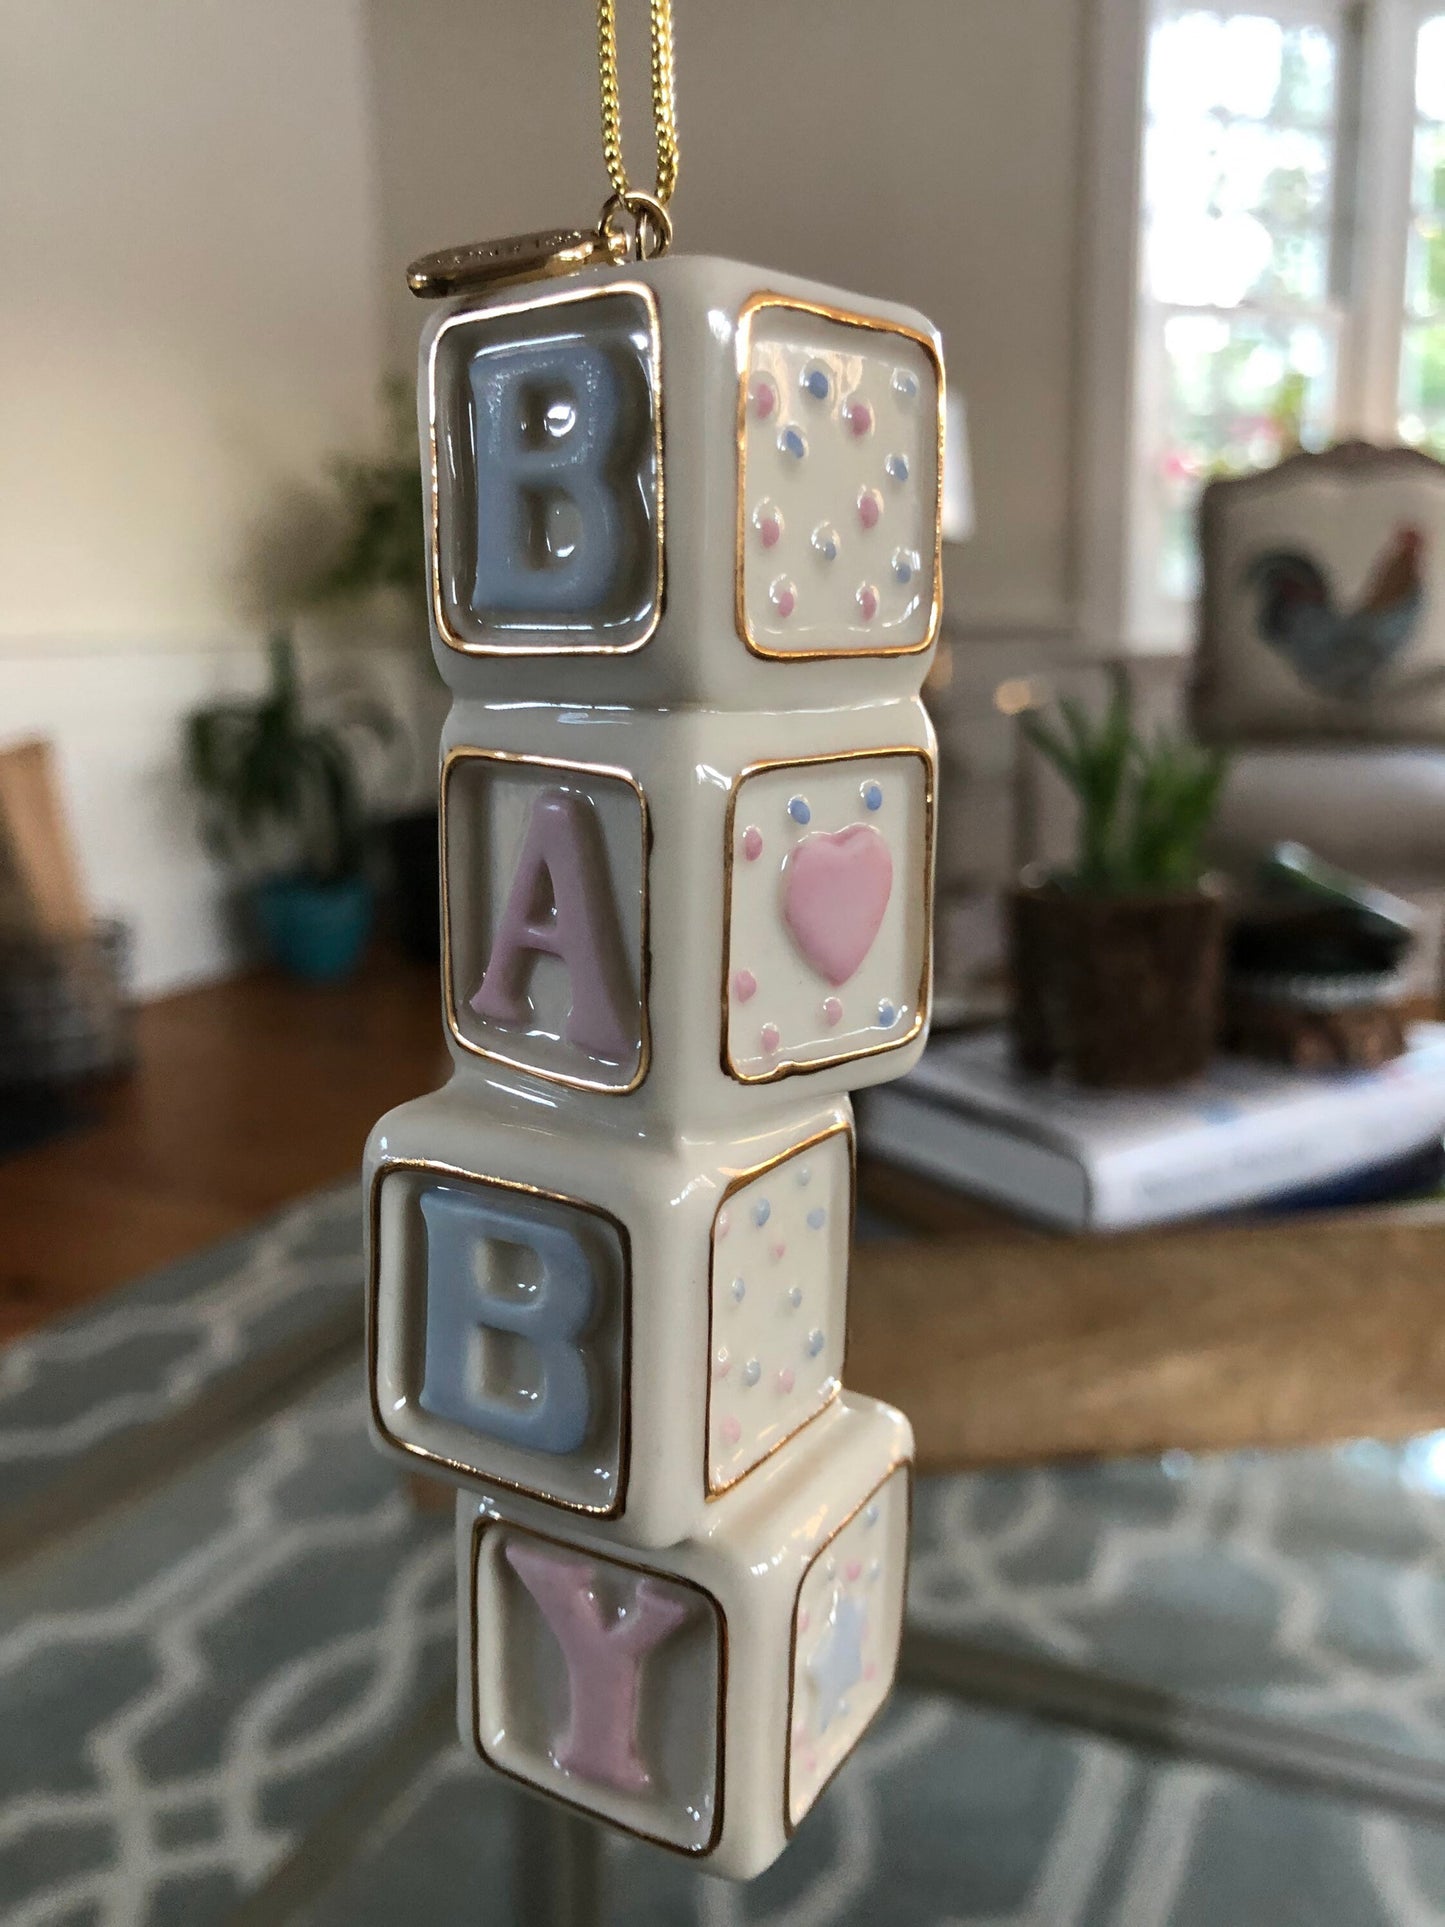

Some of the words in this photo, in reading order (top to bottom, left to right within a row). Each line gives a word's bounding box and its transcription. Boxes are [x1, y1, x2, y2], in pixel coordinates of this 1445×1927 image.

[468, 344, 622, 612] B
[469, 791, 633, 1061] A
[419, 1187, 594, 1456] B
[505, 1542, 684, 1792] Y
